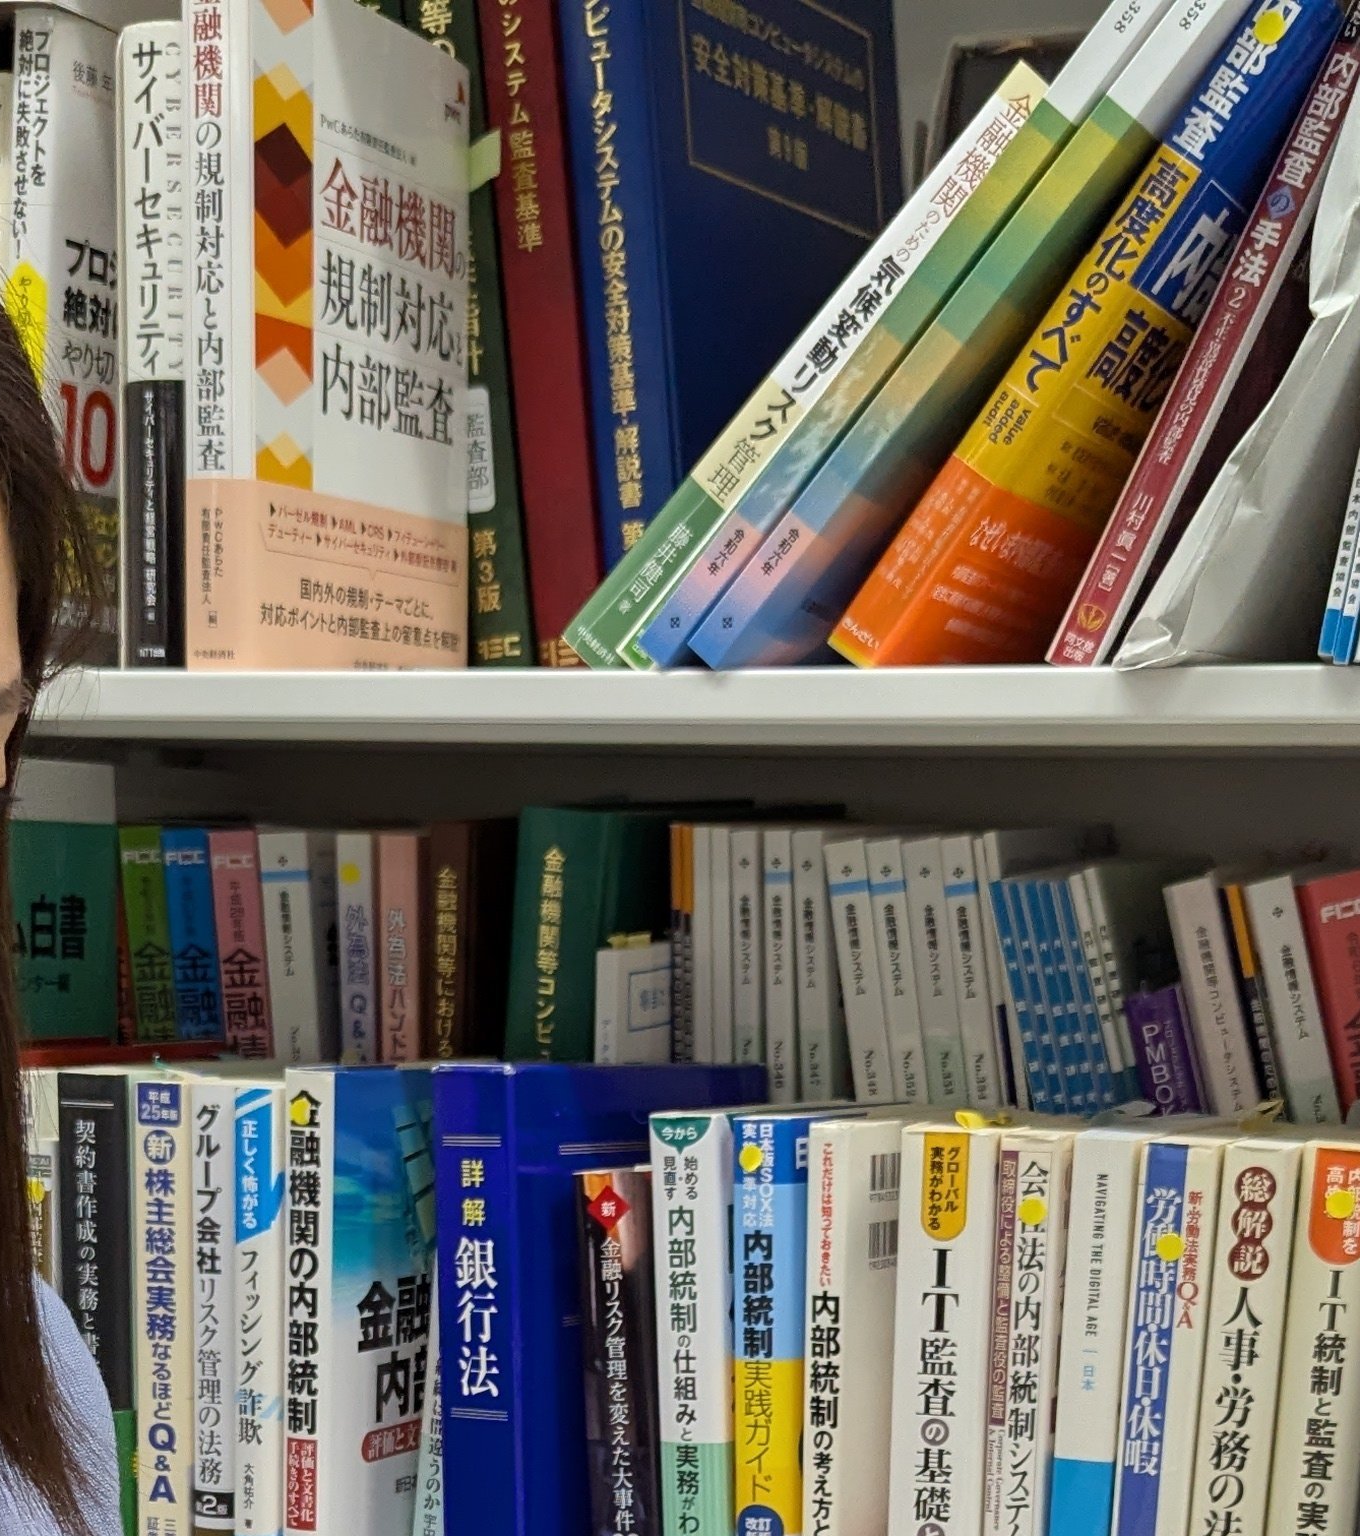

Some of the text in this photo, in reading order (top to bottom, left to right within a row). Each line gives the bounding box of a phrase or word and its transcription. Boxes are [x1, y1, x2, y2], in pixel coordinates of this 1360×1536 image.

[30, 28, 51, 188] プロジェクトを
[500, 0, 544, 253] システム監査基準
[133, 42, 166, 376] サイバーセキュリティ
[193, 0, 226, 472] 融機関の規制対応と内部監査
[583, 0, 643, 509] ピュータシステムの安全対策基準・解説書
[1026, 156, 1191, 394] 高度化のすべて
[707, 94, 1034, 504] 金融機関のための気候変動リスク管理
[59, 380, 117, 487] 10
[321, 351, 455, 446] 内部監査
[982, 391, 1009, 428] audit
[987, 399, 1021, 445] added
[1004, 408, 1031, 446] value
[467, 412, 489, 490] 監査部
[474, 530, 502, 613] 第3版
[707, 528, 745, 577] 令和六年
[760, 528, 800, 577] 令和六年
[148, 1091, 170, 1105] 平成
[661, 1126, 699, 1141] 今から
[146, 1133, 173, 1158] 新
[242, 1119, 259, 1230] 正しく怖がる
[663, 1156, 678, 1200] 見直す
[684, 1156, 698, 1200] 始める
[943, 1146, 961, 1212] グローバル
[820, 1143, 835, 1287] これだけは知っておきたい
[928, 1146, 945, 1231] 実務がわかる
[1230, 1172, 1277, 1278] 総解説
[195, 1104, 223, 1485] グループ会社リスク管理の法務
[1085, 1174, 1109, 1336] NAVIGATING THE DIGITAL AGE
[455, 1238, 501, 1399] 銀行法
[1081, 1365, 1095, 1391] 日本
[301, 1440, 315, 1523] 評価と文書化
